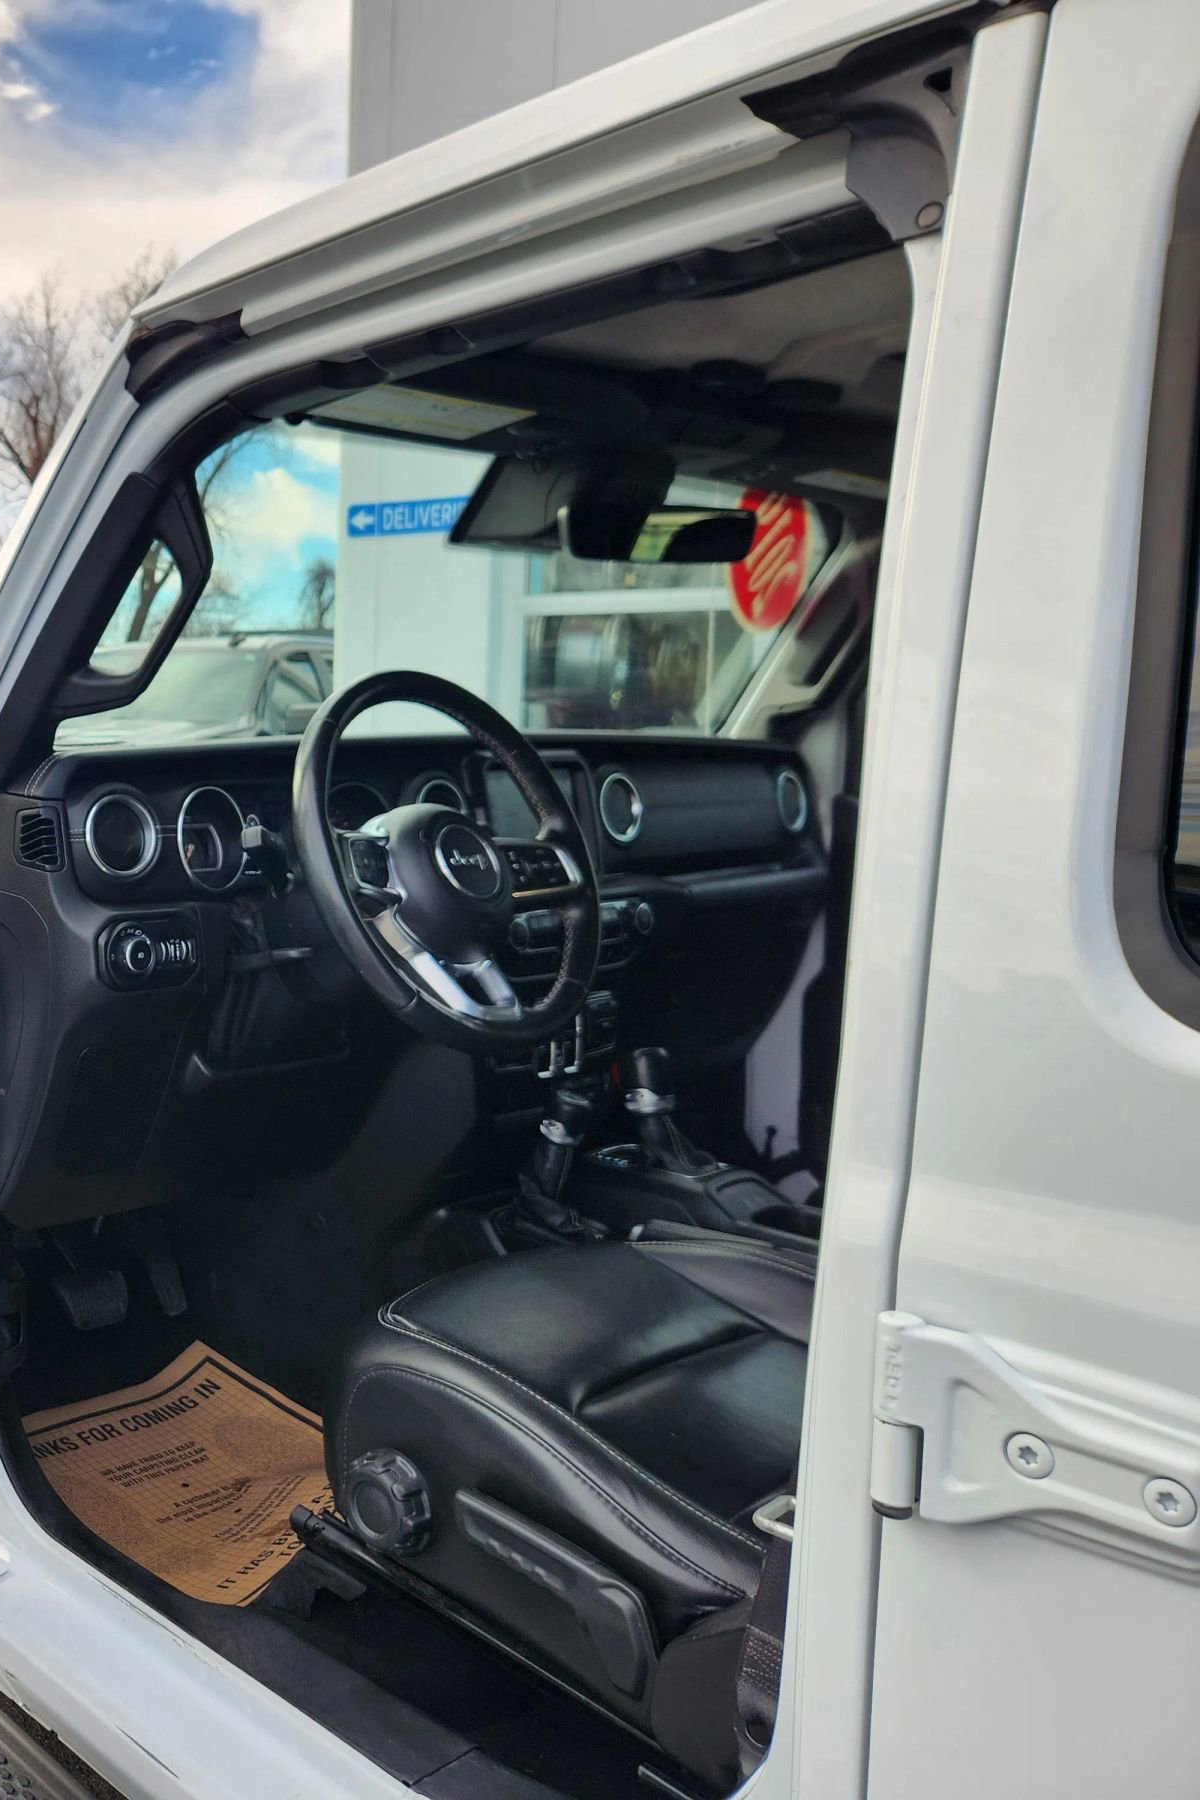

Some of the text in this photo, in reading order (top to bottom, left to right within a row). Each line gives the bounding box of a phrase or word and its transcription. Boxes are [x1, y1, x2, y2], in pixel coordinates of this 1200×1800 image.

[76, 1423, 122, 1445] FOR
[120, 1395, 199, 1432] COMING
[194, 1377, 221, 1399] IN
[107, 1446, 206, 1483] YOUR CARPETING CLEAN
[115, 1461, 139, 1472] HAVE
[138, 1453, 164, 1464] TRIED
[175, 1440, 196, 1452] KEEP
[121, 1454, 210, 1488] WITH THIS PAPER MAT
[276, 1541, 301, 1558] TO
[217, 1577, 236, 1589] IT
[236, 1549, 274, 1575] HAS
